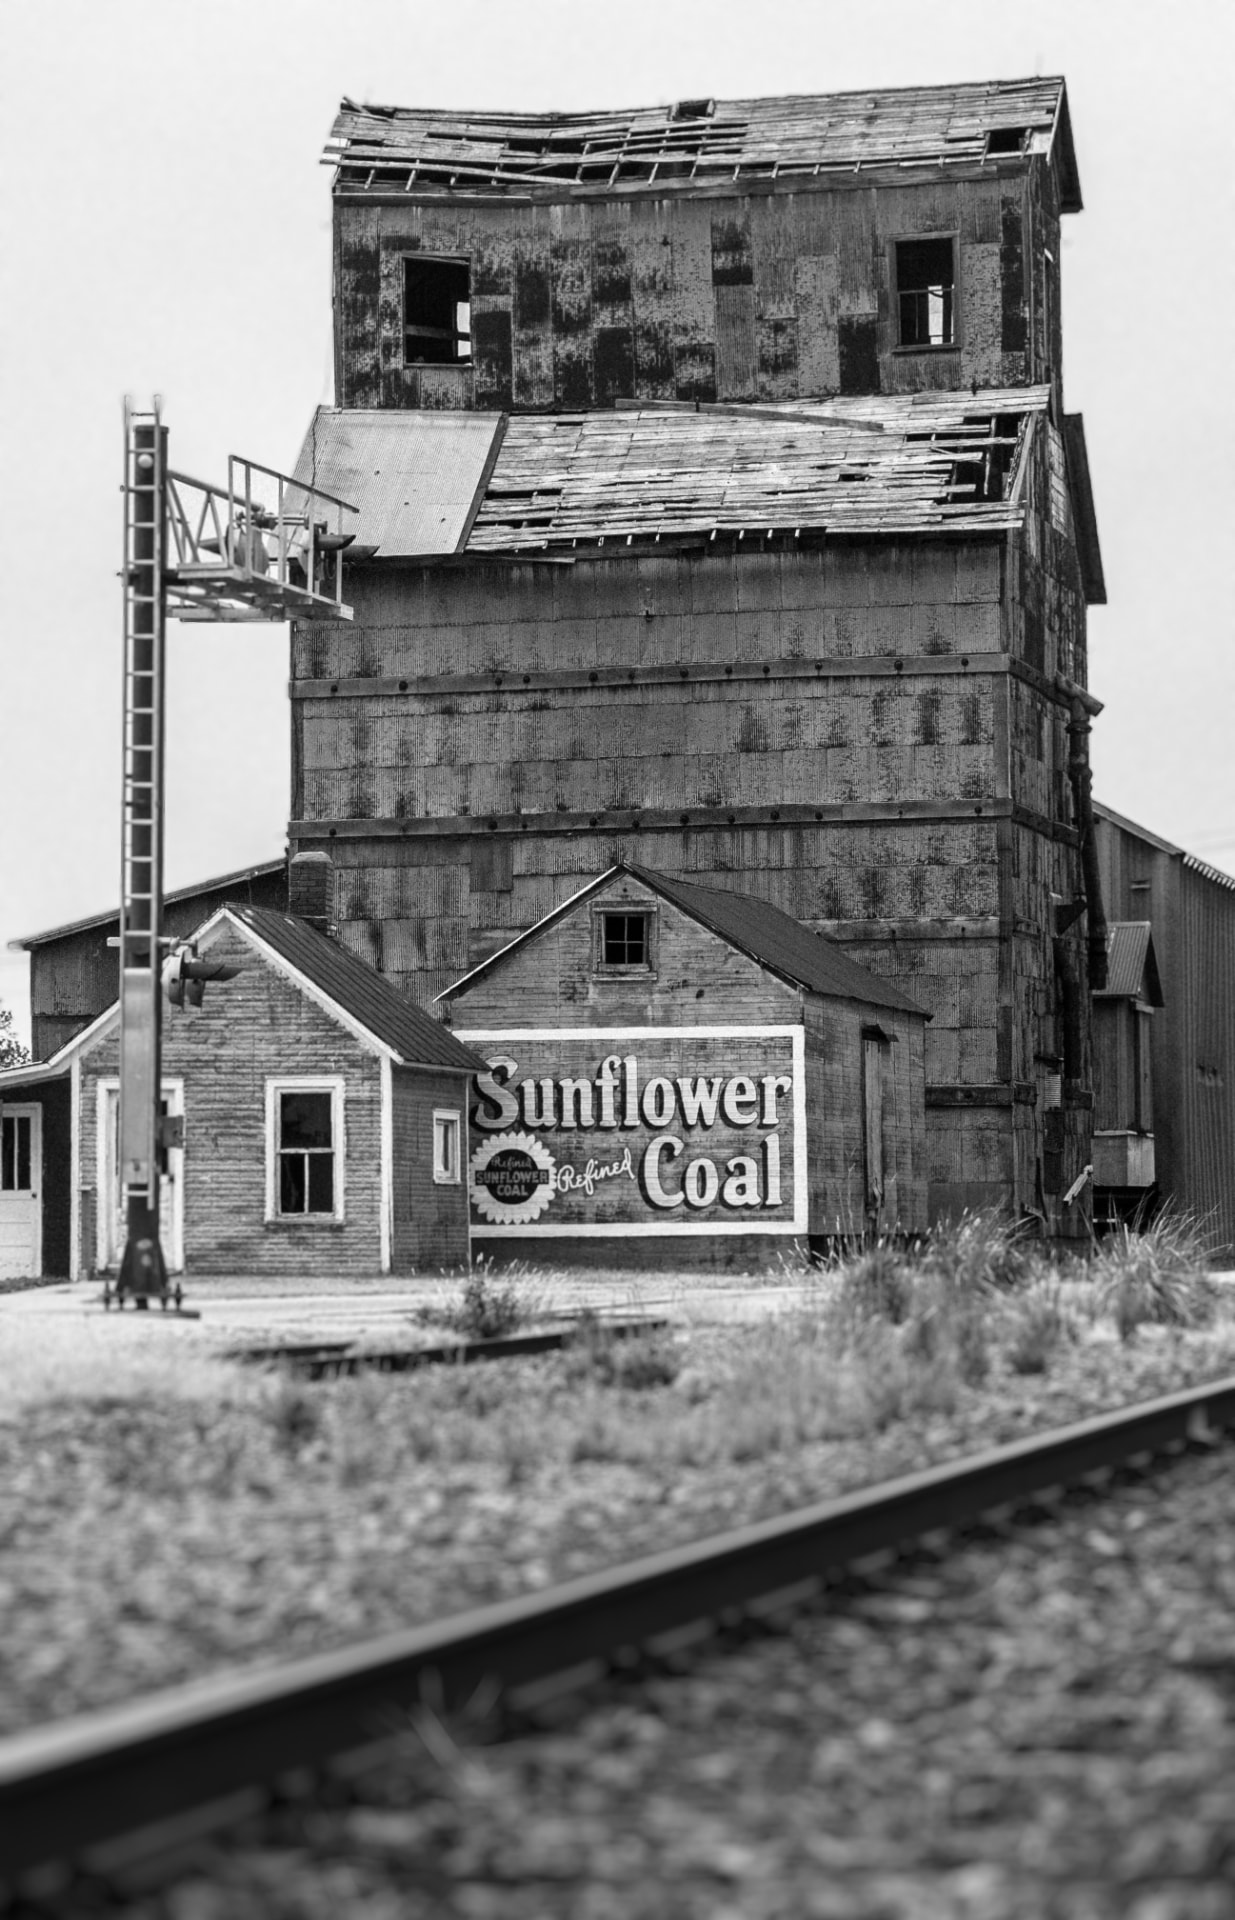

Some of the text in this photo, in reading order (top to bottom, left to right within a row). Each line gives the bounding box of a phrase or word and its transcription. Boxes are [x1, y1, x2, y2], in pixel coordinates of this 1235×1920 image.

[472, 1055, 793, 1130] Sunflower
[476, 1170, 549, 1184] SUNFLOWER
[497, 1184, 529, 1197] COAL
[556, 1132, 784, 1209] Refined Coal
